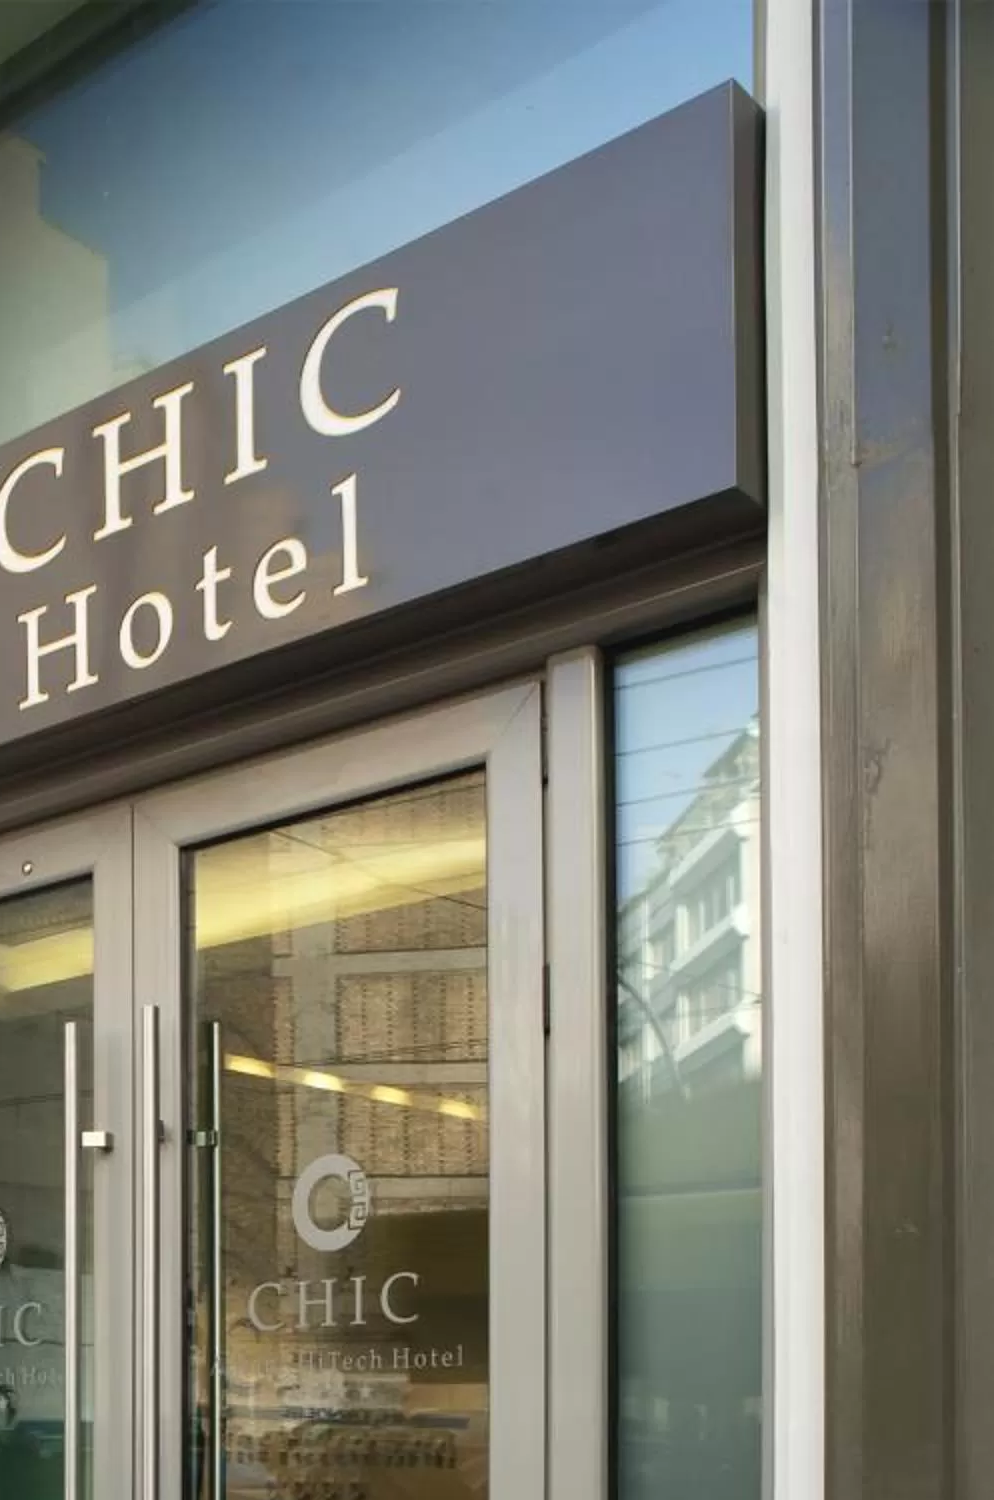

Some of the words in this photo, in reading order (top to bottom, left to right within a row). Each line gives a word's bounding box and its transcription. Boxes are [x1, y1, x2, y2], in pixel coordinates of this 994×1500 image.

[16, 471, 370, 711] Hotel
[246, 1270, 421, 1332] CHIC
[298, 1350, 383, 1371] HiTech
[392, 1345, 464, 1370] Hotel
